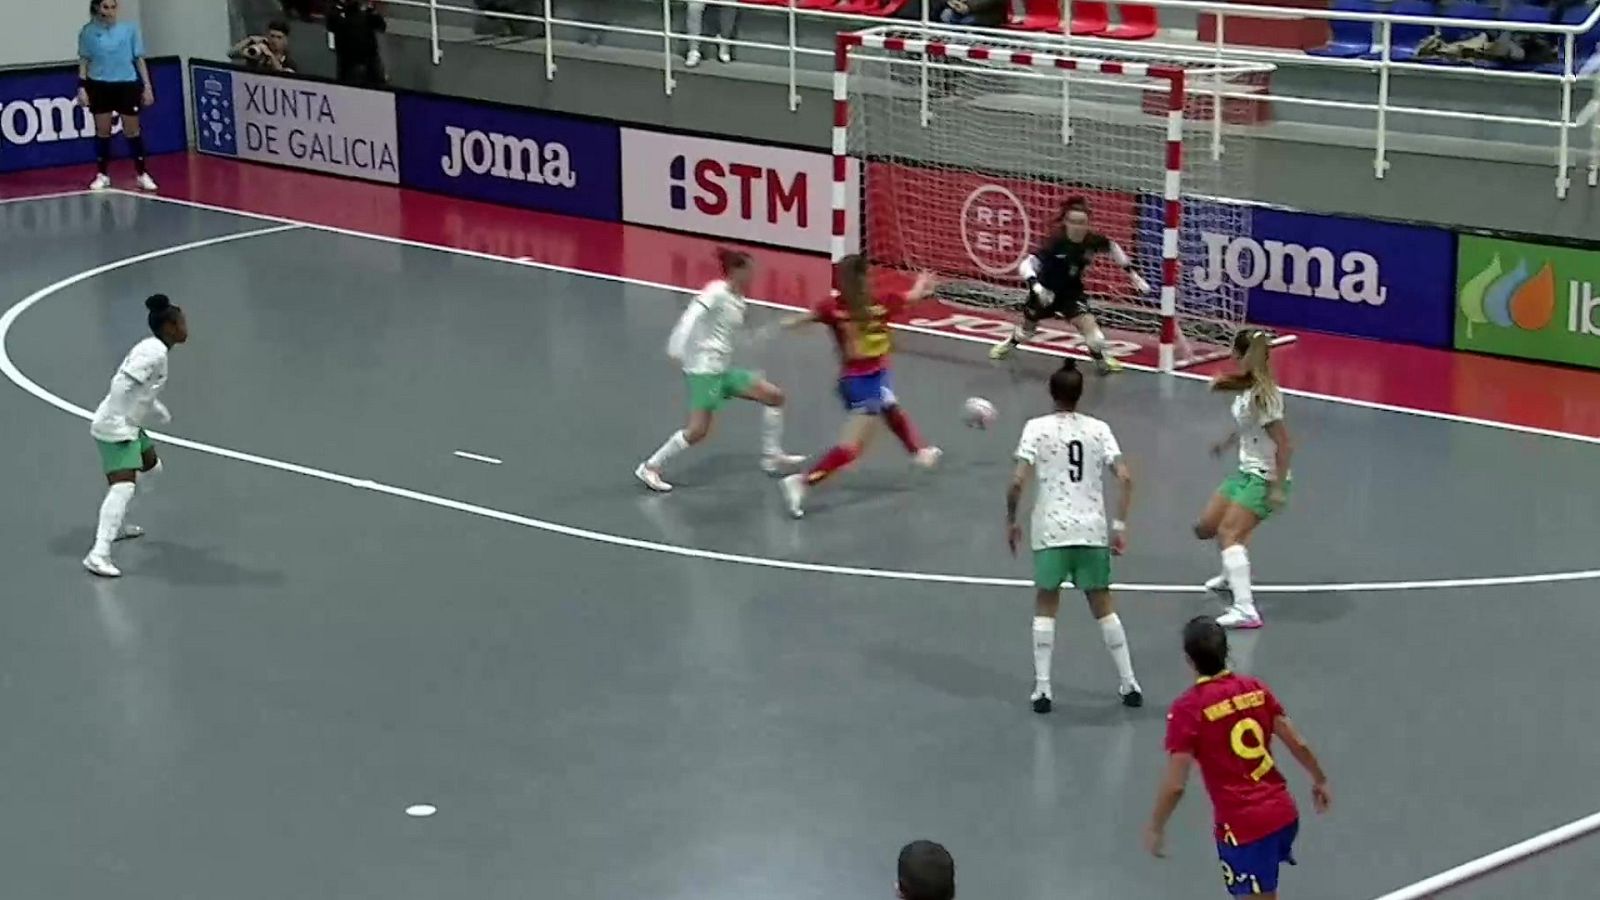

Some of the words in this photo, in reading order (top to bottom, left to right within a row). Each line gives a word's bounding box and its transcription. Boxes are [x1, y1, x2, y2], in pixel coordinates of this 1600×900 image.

[244, 81, 336, 125] XUNTA
[245, 122, 283, 155] DE
[289, 128, 399, 174] GALICIA
[1067, 439, 1084, 483] 9
[1229, 717, 1275, 783] 9
